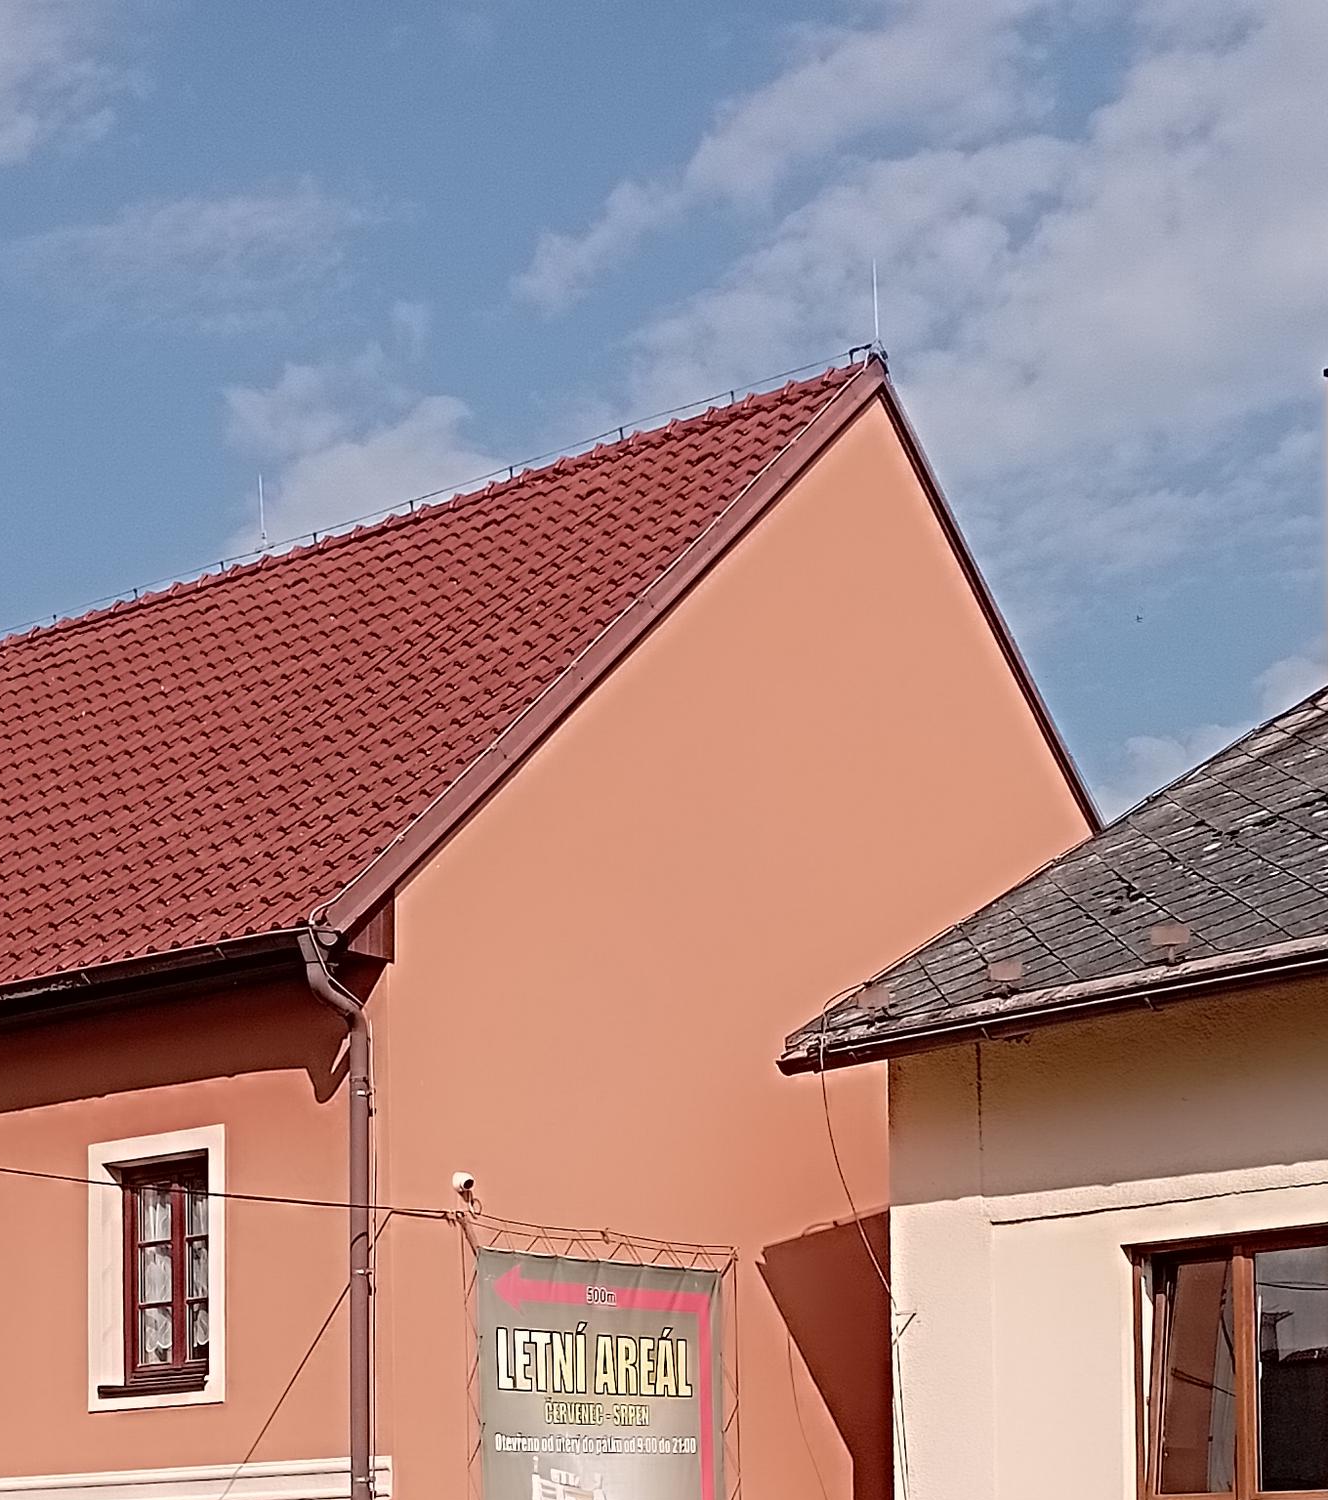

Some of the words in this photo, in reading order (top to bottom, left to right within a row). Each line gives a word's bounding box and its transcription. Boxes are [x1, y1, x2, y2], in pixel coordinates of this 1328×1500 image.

[586, 1286, 617, 1306] 500m
[496, 1322, 588, 1394] LETNÍ
[594, 1327, 692, 1397] AREÁL
[544, 1397, 604, 1425] ČERVENEC
[613, 1403, 650, 1426] SRPEN
[495, 1432, 540, 1452] Otevřeno
[541, 1434, 554, 1453] od
[582, 1435, 594, 1454] do
[624, 1436, 636, 1454] od
[659, 1436, 671, 1455] do
